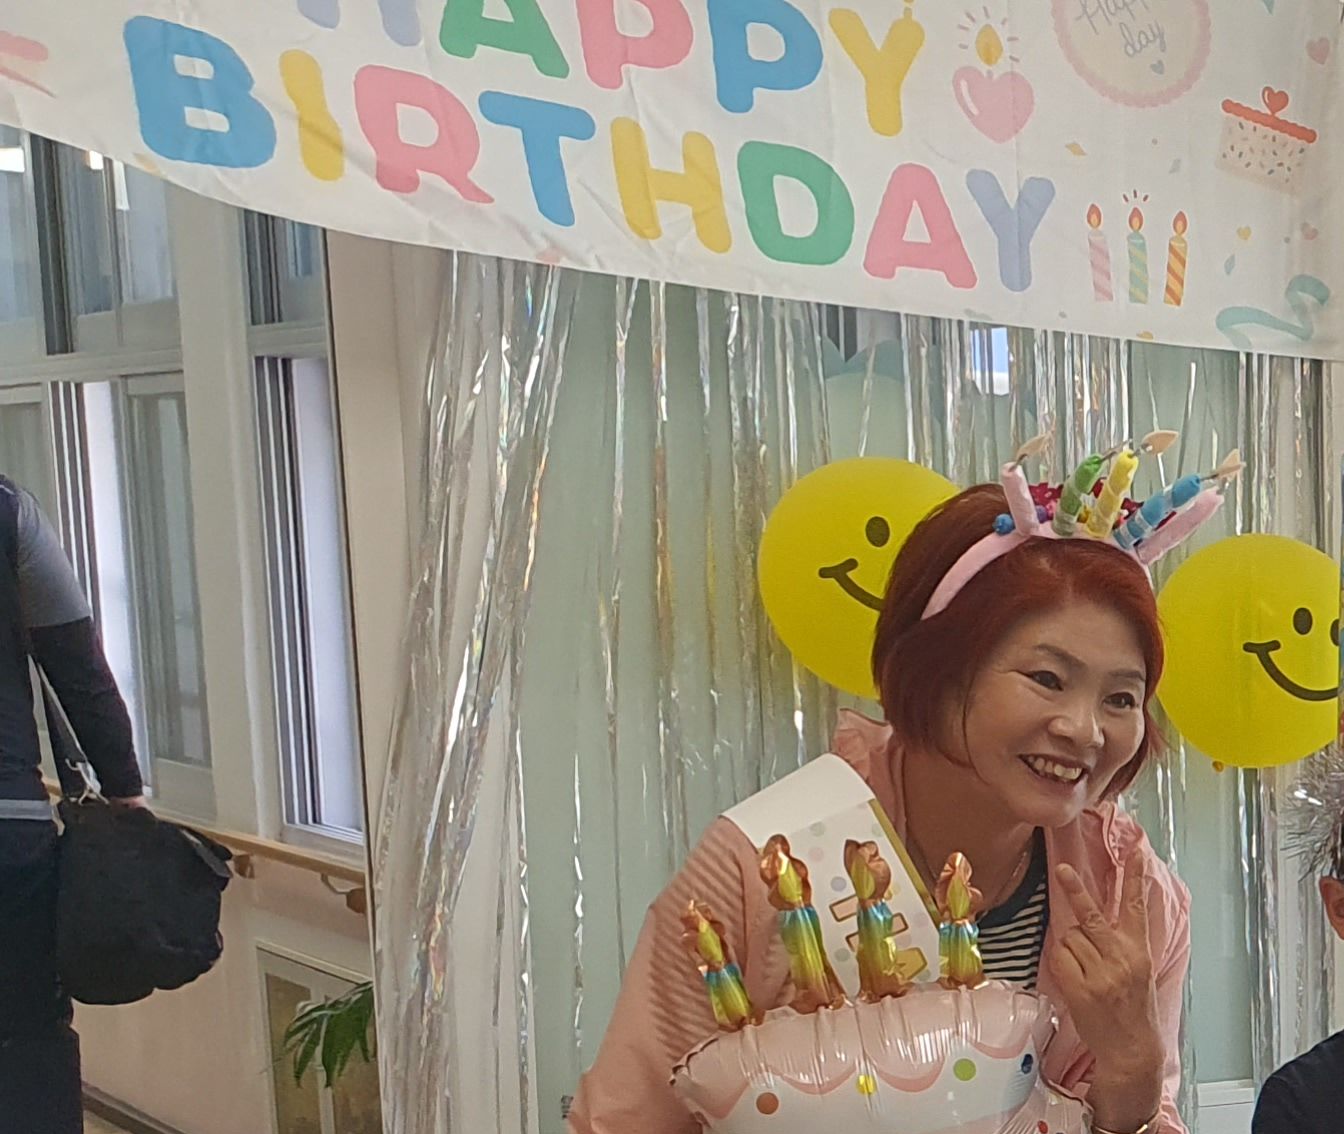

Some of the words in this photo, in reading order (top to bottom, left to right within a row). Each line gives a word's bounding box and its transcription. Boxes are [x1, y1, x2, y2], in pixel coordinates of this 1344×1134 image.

[297, 0, 926, 137] APPY
[1119, 19, 1167, 57] day
[123, 15, 1056, 292] BIRTHDAY
